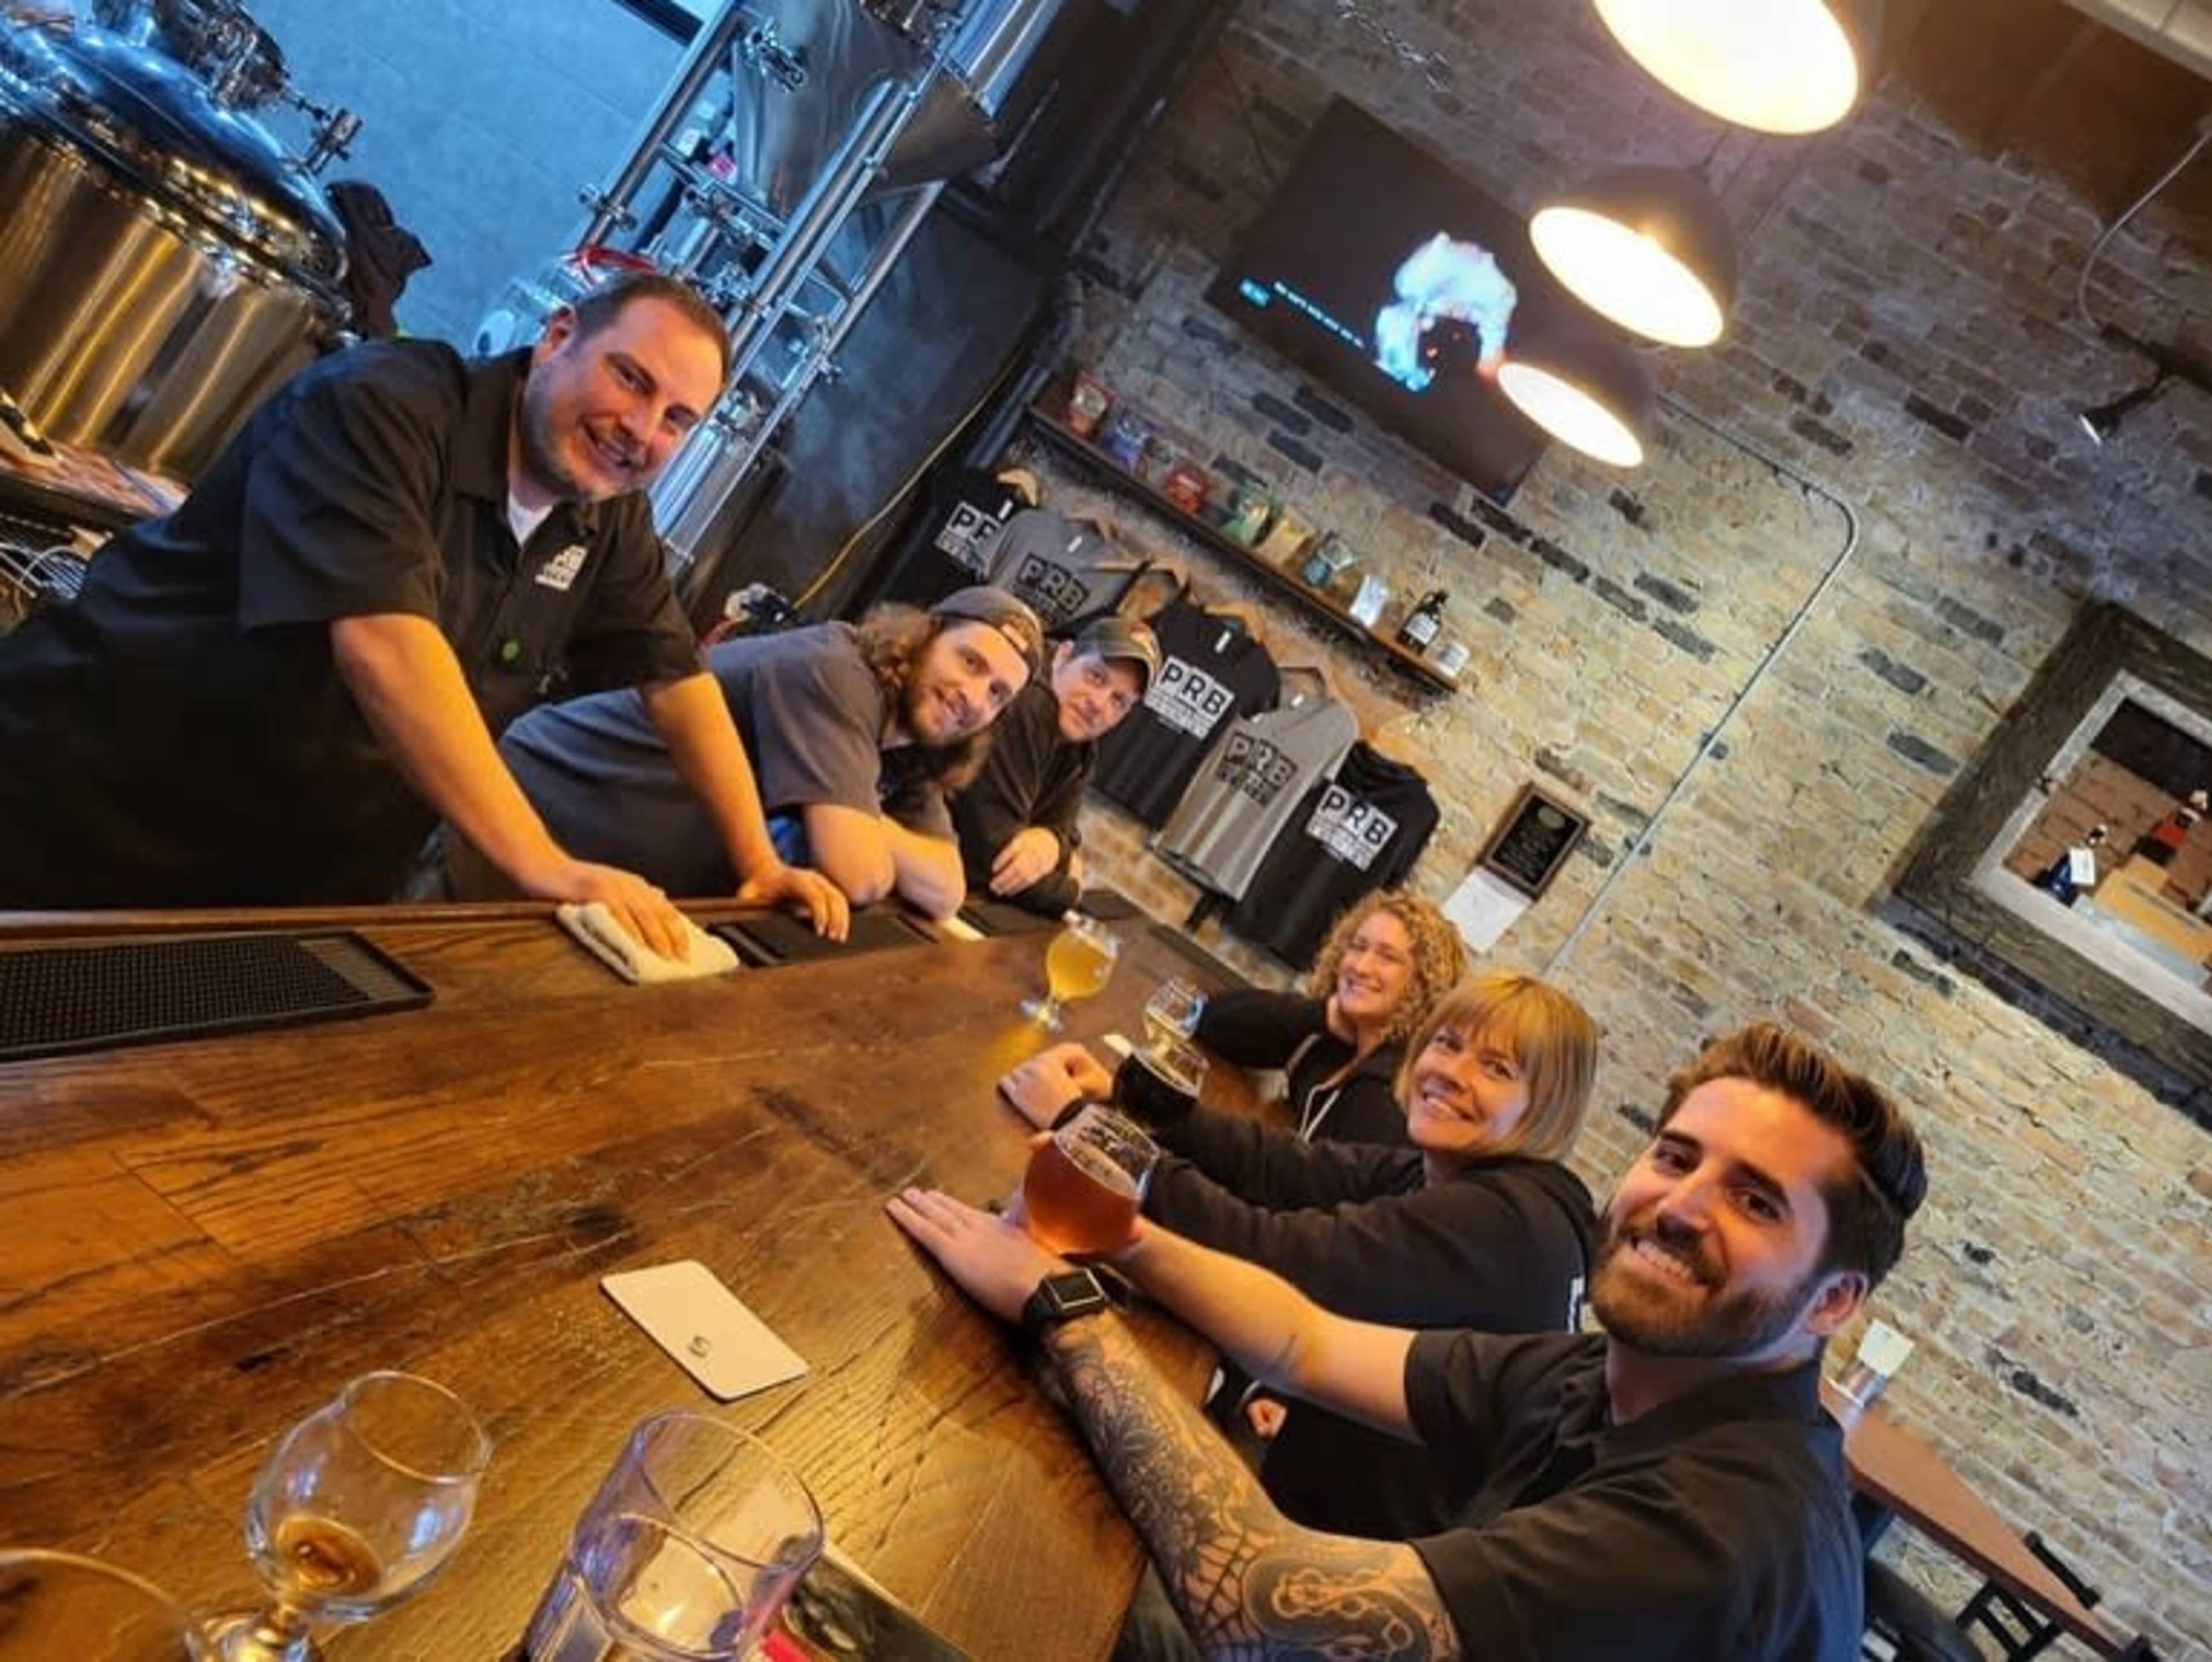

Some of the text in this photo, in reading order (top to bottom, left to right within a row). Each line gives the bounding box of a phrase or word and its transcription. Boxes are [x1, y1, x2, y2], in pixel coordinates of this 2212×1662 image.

[1020, 559, 1083, 611] PRB
[1161, 664, 1226, 716] PRB
[1227, 736, 1293, 784] PRB
[1321, 790, 1388, 845] PRB
